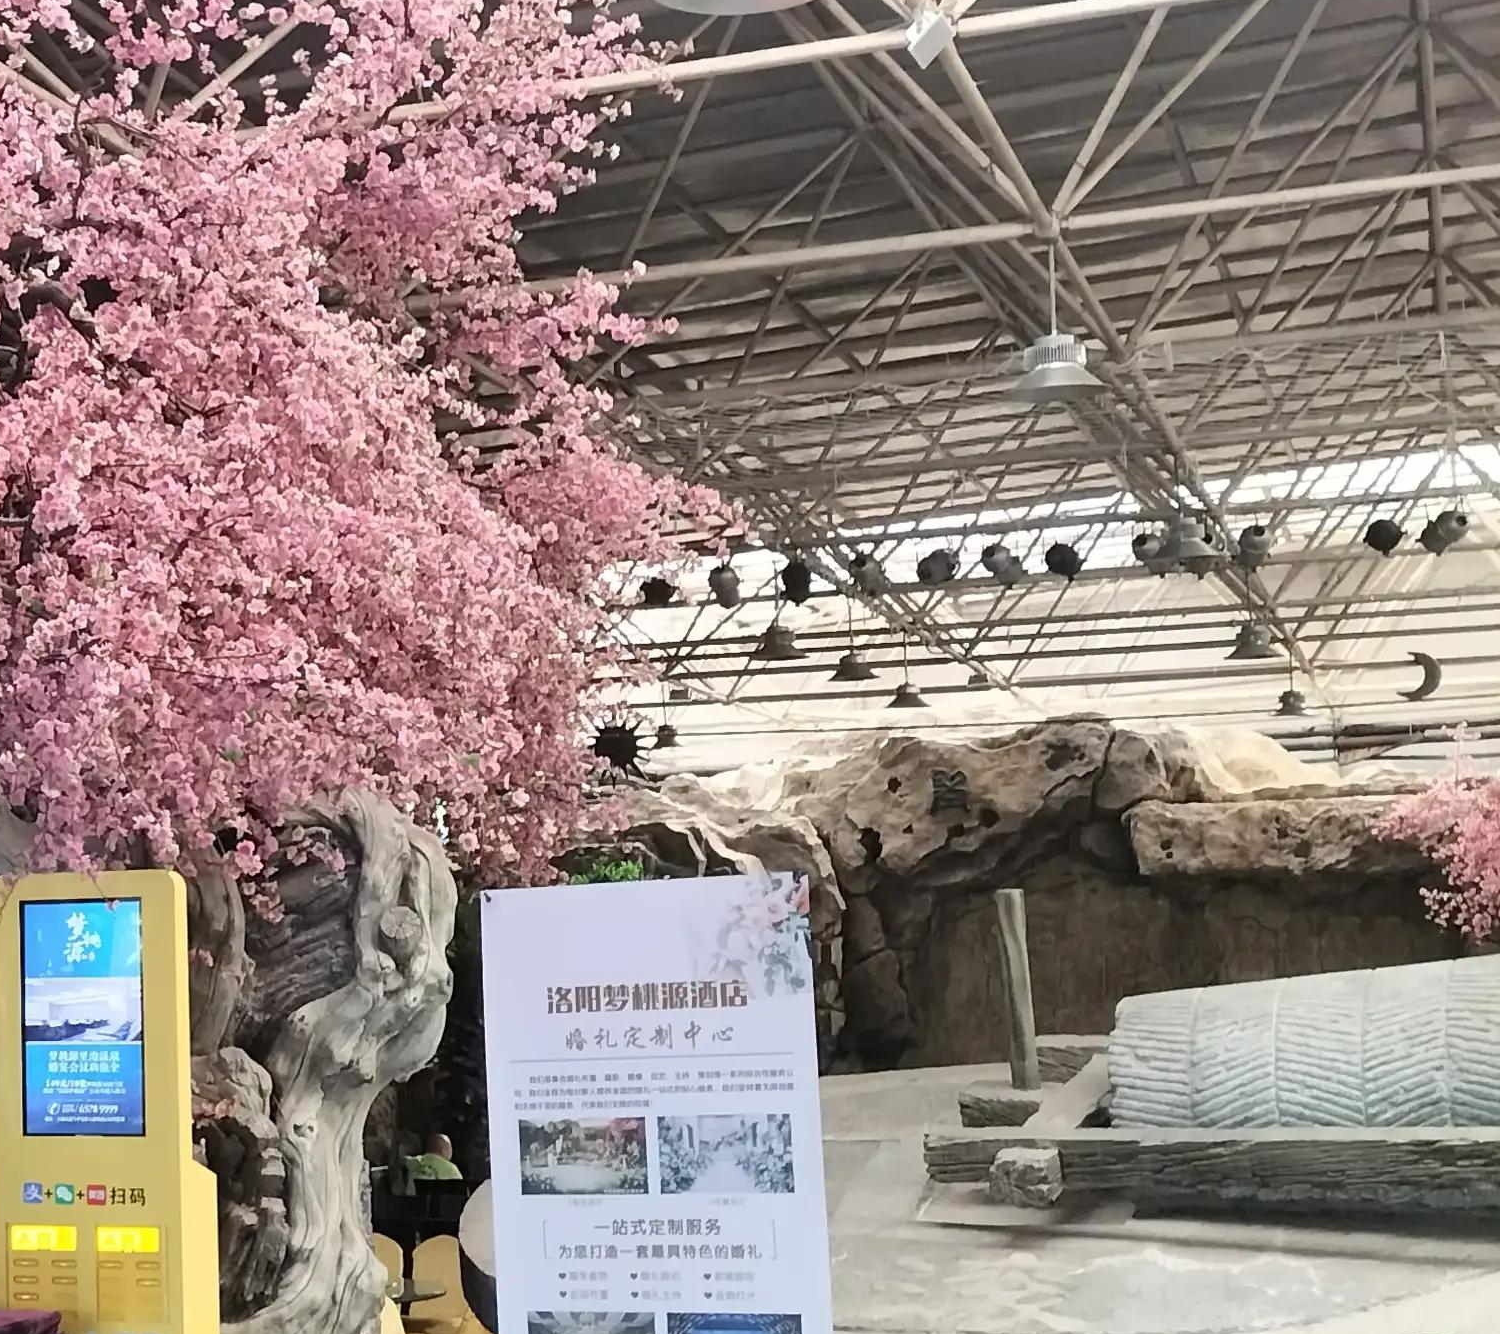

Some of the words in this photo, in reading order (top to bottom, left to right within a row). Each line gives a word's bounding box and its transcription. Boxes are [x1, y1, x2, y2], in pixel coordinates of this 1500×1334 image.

[546, 979, 749, 1014] 洛阳梦桃源酒店
[564, 1021, 736, 1052] 婚礼定制中心
[110, 1187, 147, 1207] 扫码
[593, 1218, 722, 1236] 一站式定制服务
[558, 1244, 763, 1260] 为您打造一套最具特色的婚礼
